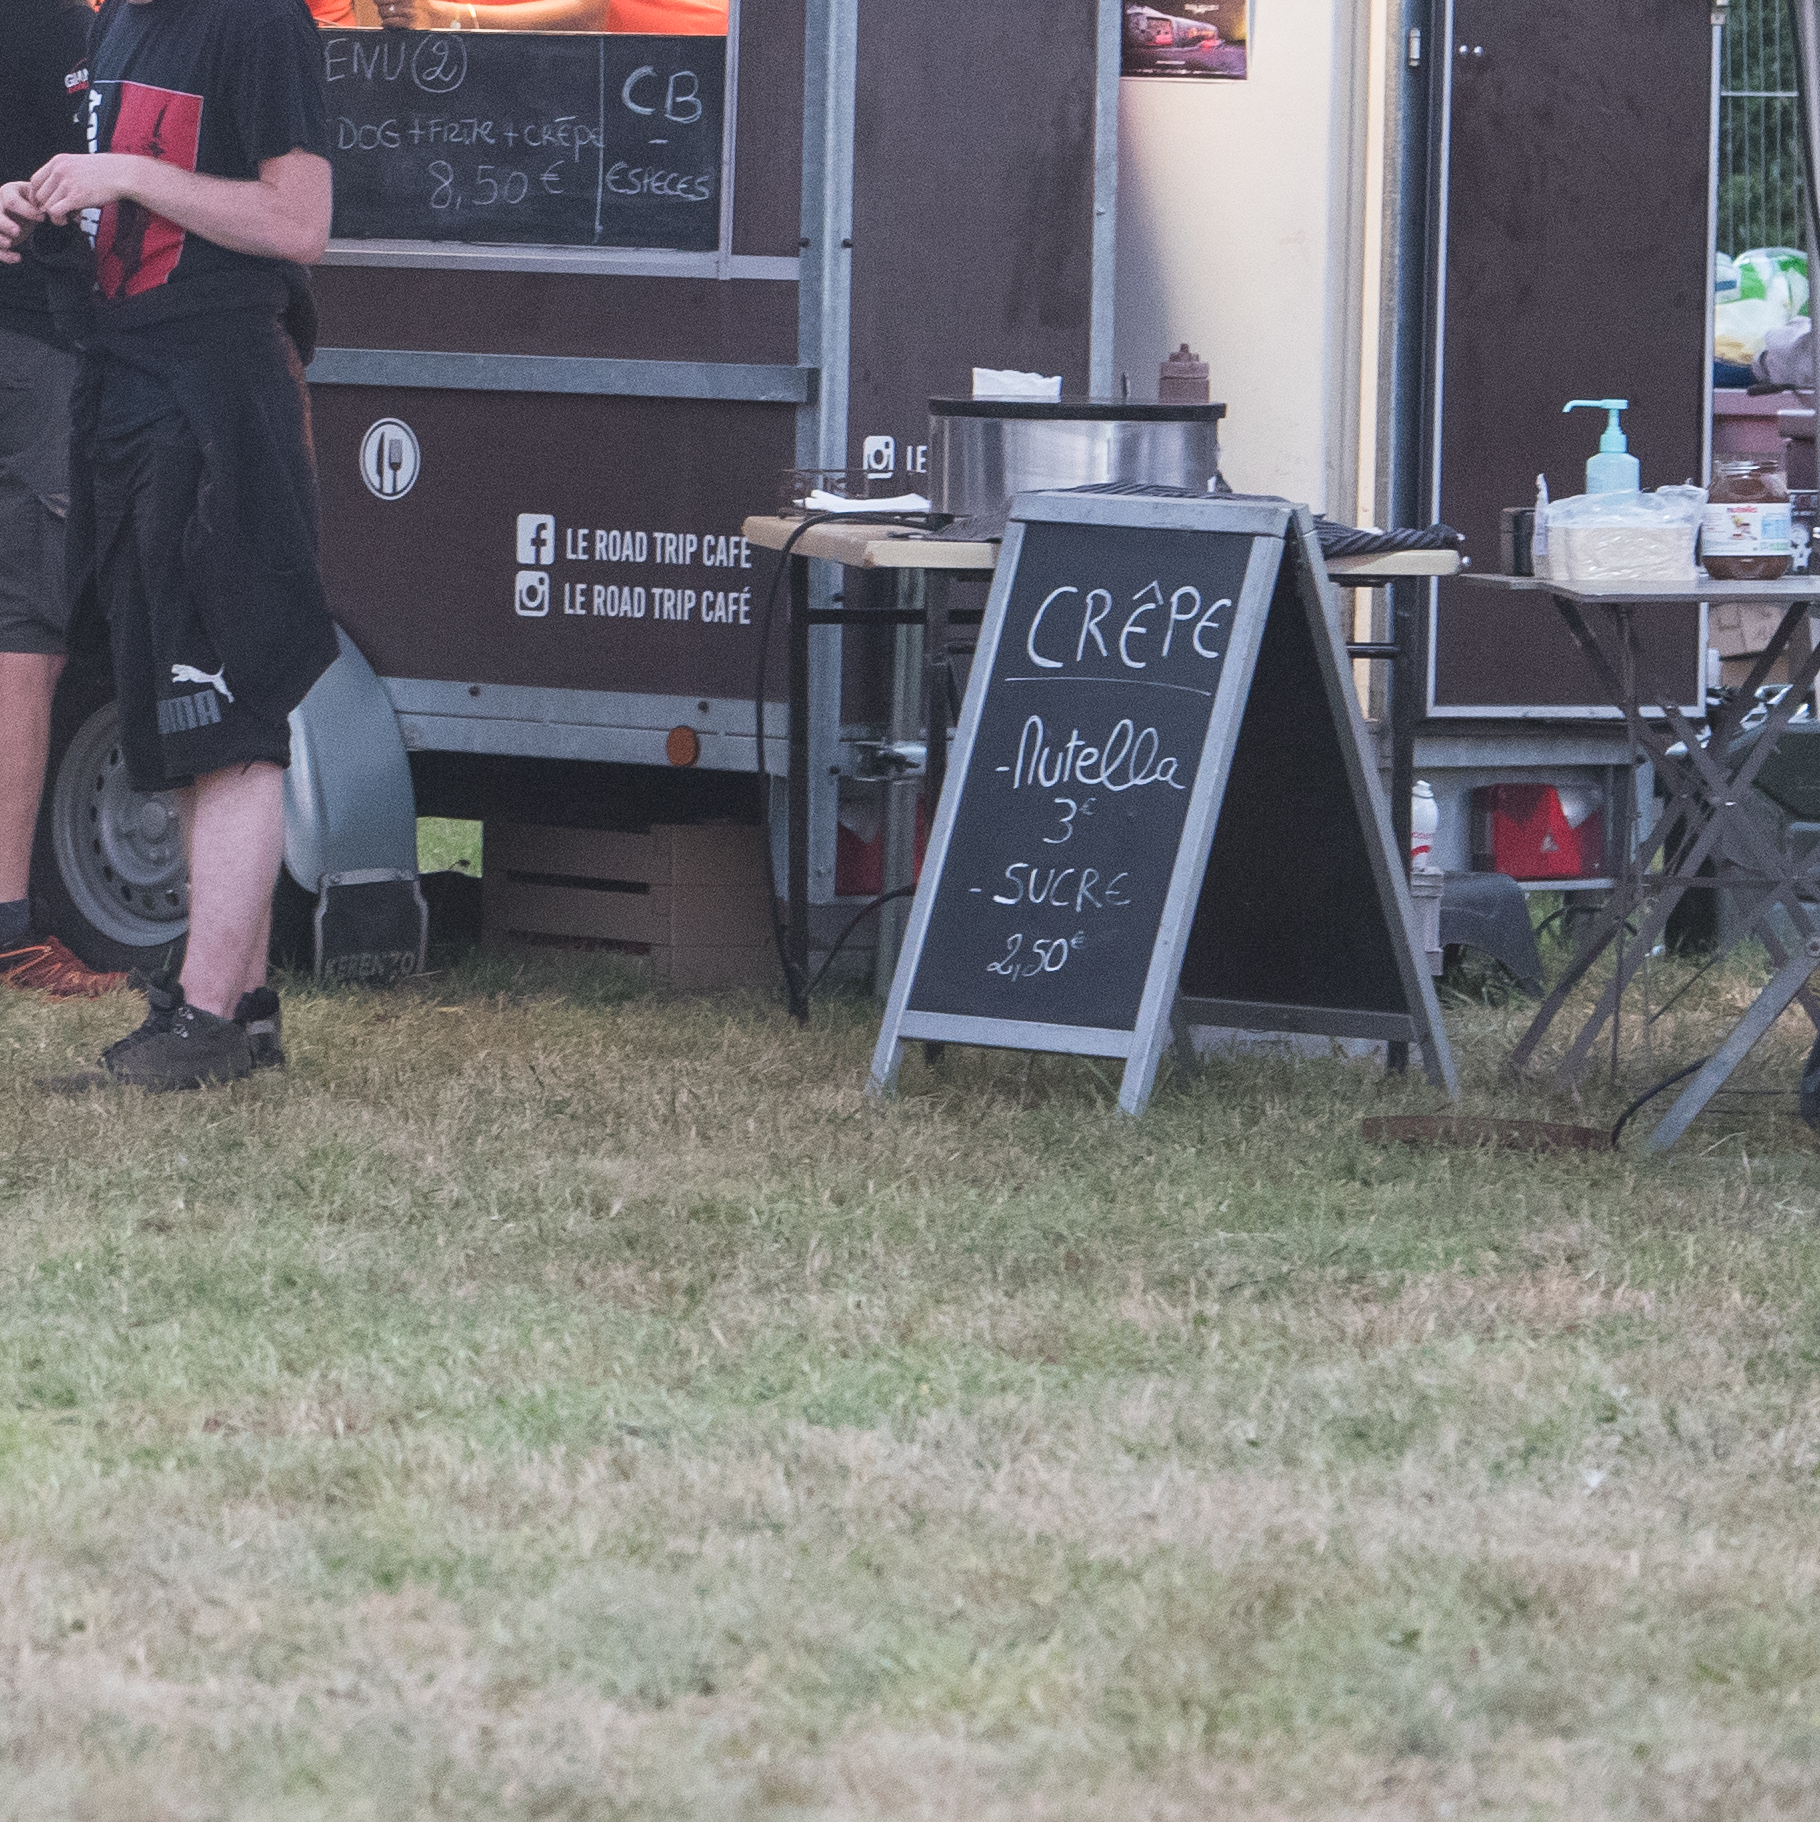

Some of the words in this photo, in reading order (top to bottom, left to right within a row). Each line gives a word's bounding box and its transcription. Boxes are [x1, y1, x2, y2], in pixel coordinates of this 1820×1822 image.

[325, 38, 406, 81] ENU
[622, 65, 703, 124] CB
[566, 528, 589, 561] LE
[594, 529, 648, 563] ROAD
[653, 531, 698, 566] TRIP
[564, 582, 587, 616] LE
[593, 584, 646, 618] ROAD
[651, 586, 696, 621] TRIP
[701, 585, 751, 625] CAFÉ
[1027, 580, 1233, 669] CRÊPE
[993, 862, 1132, 913] SUCRE
